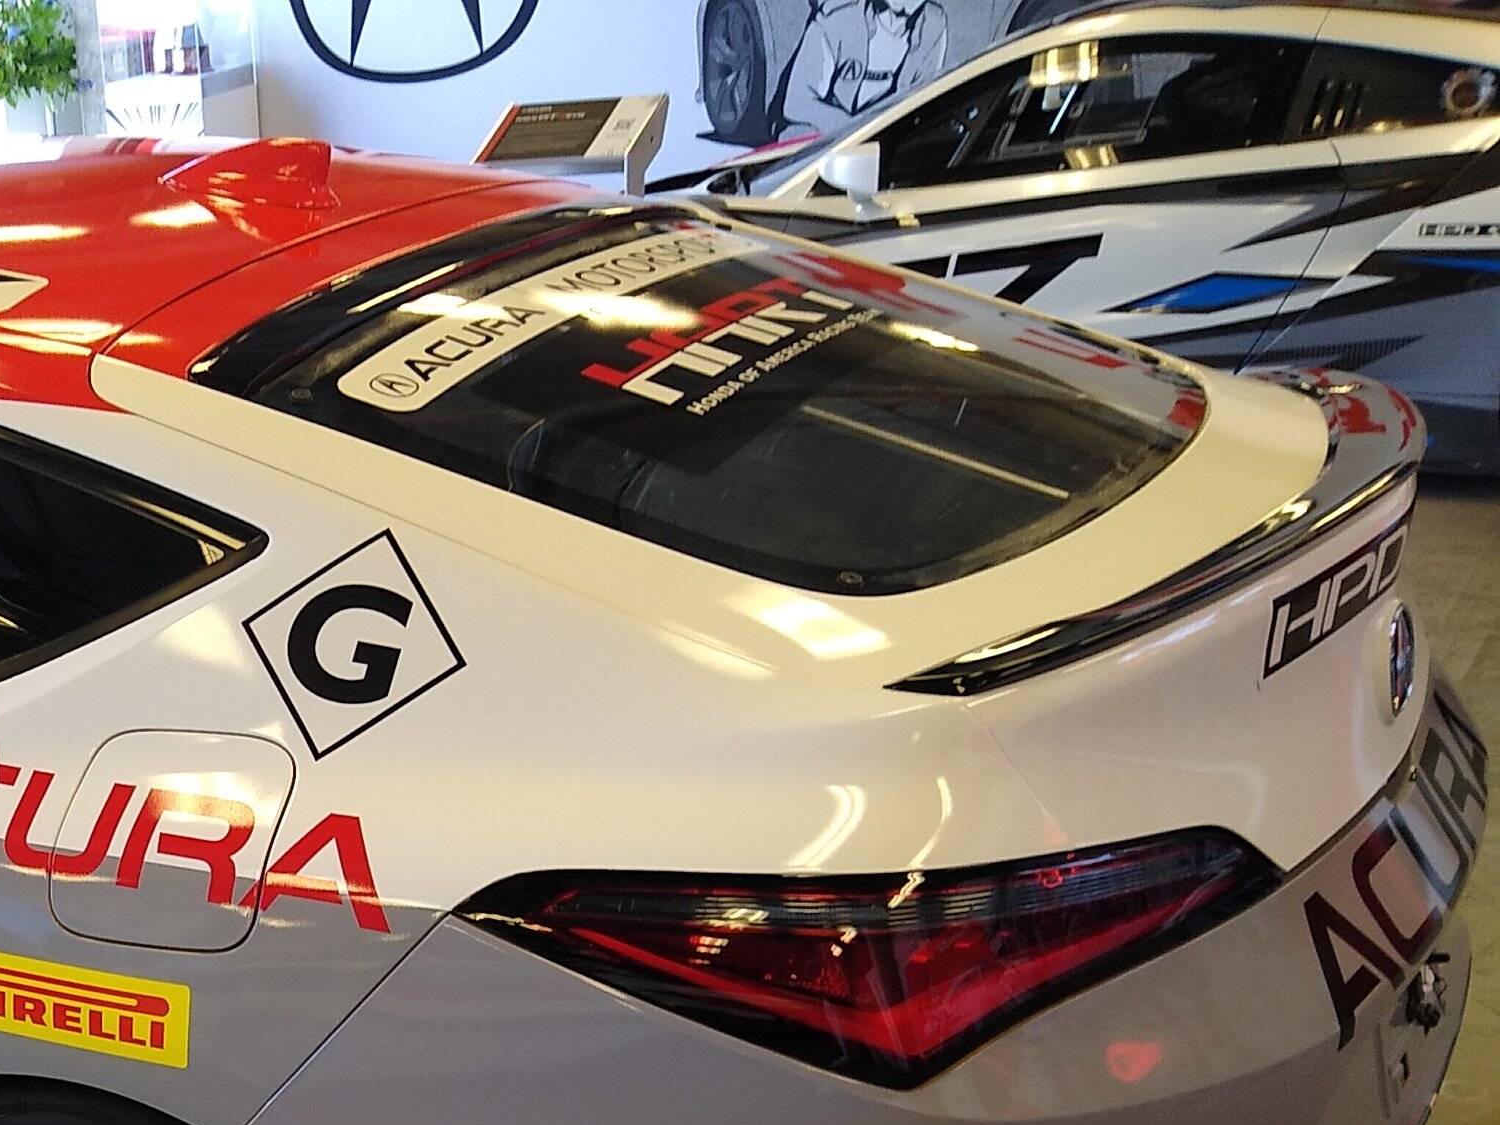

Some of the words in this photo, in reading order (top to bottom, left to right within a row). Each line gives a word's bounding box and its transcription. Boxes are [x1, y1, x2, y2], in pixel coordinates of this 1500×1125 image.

[409, 303, 548, 383] ACURA
[685, 379, 745, 417] HONDA
[286, 583, 414, 705] G
[1267, 524, 1409, 669] HPD
[1303, 690, 1489, 1053] ACURA
